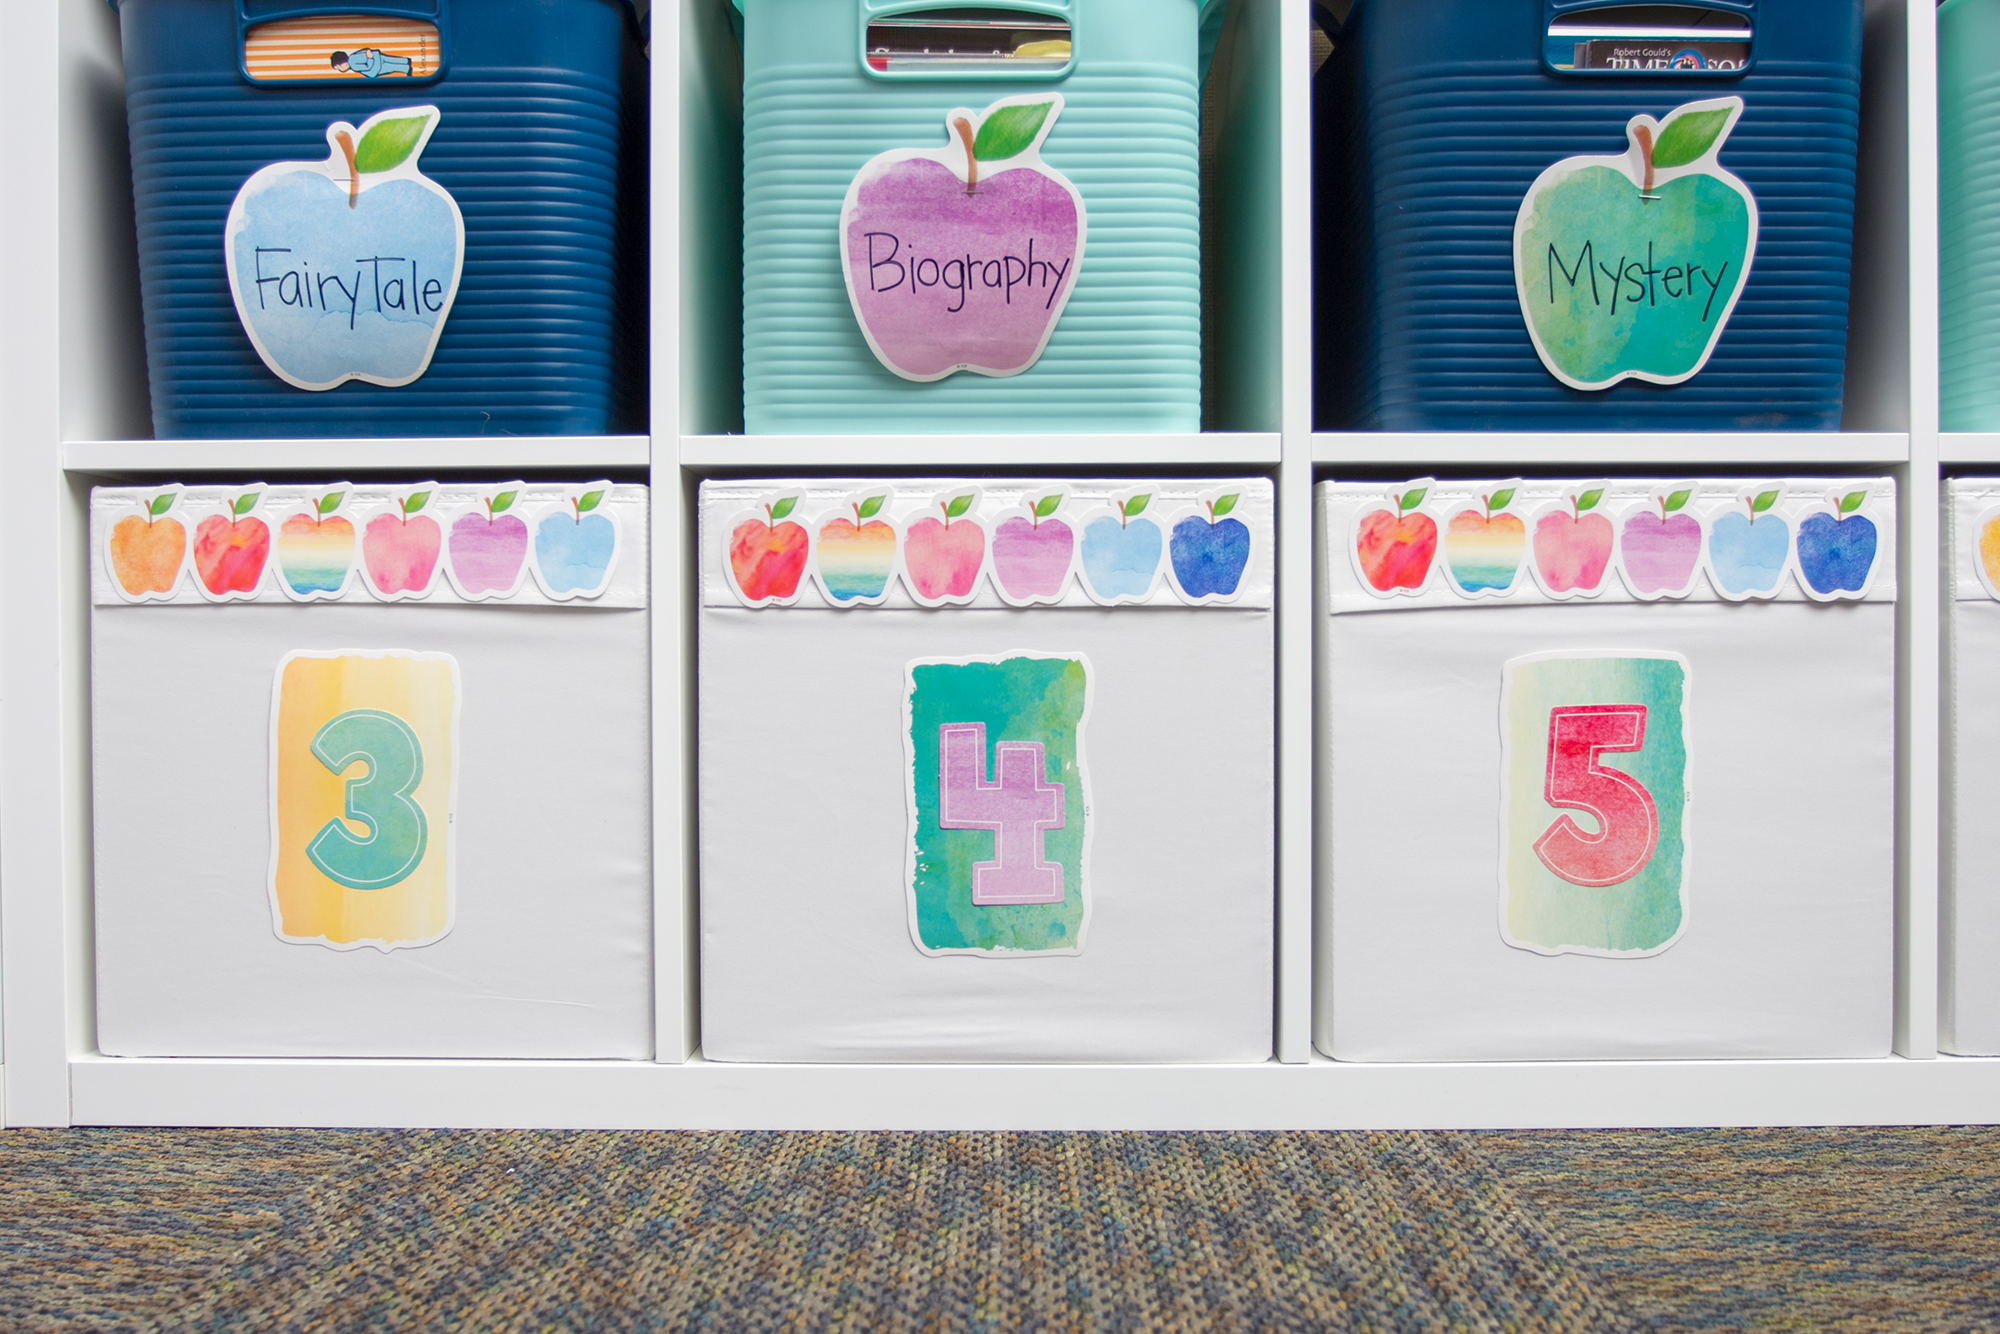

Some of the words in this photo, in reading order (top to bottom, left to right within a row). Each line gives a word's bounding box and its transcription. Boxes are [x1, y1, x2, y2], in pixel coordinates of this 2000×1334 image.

[418, 34, 426, 76] Alexander
[1613, 48, 1641, 57] Robert
[1642, 48, 1672, 57] Gould's
[864, 232, 1070, 312] Biography
[1548, 240, 1728, 322] Mystery
[305, 708, 428, 890] 3
[939, 722, 1065, 906] 4
[1532, 704, 1659, 887] 5
